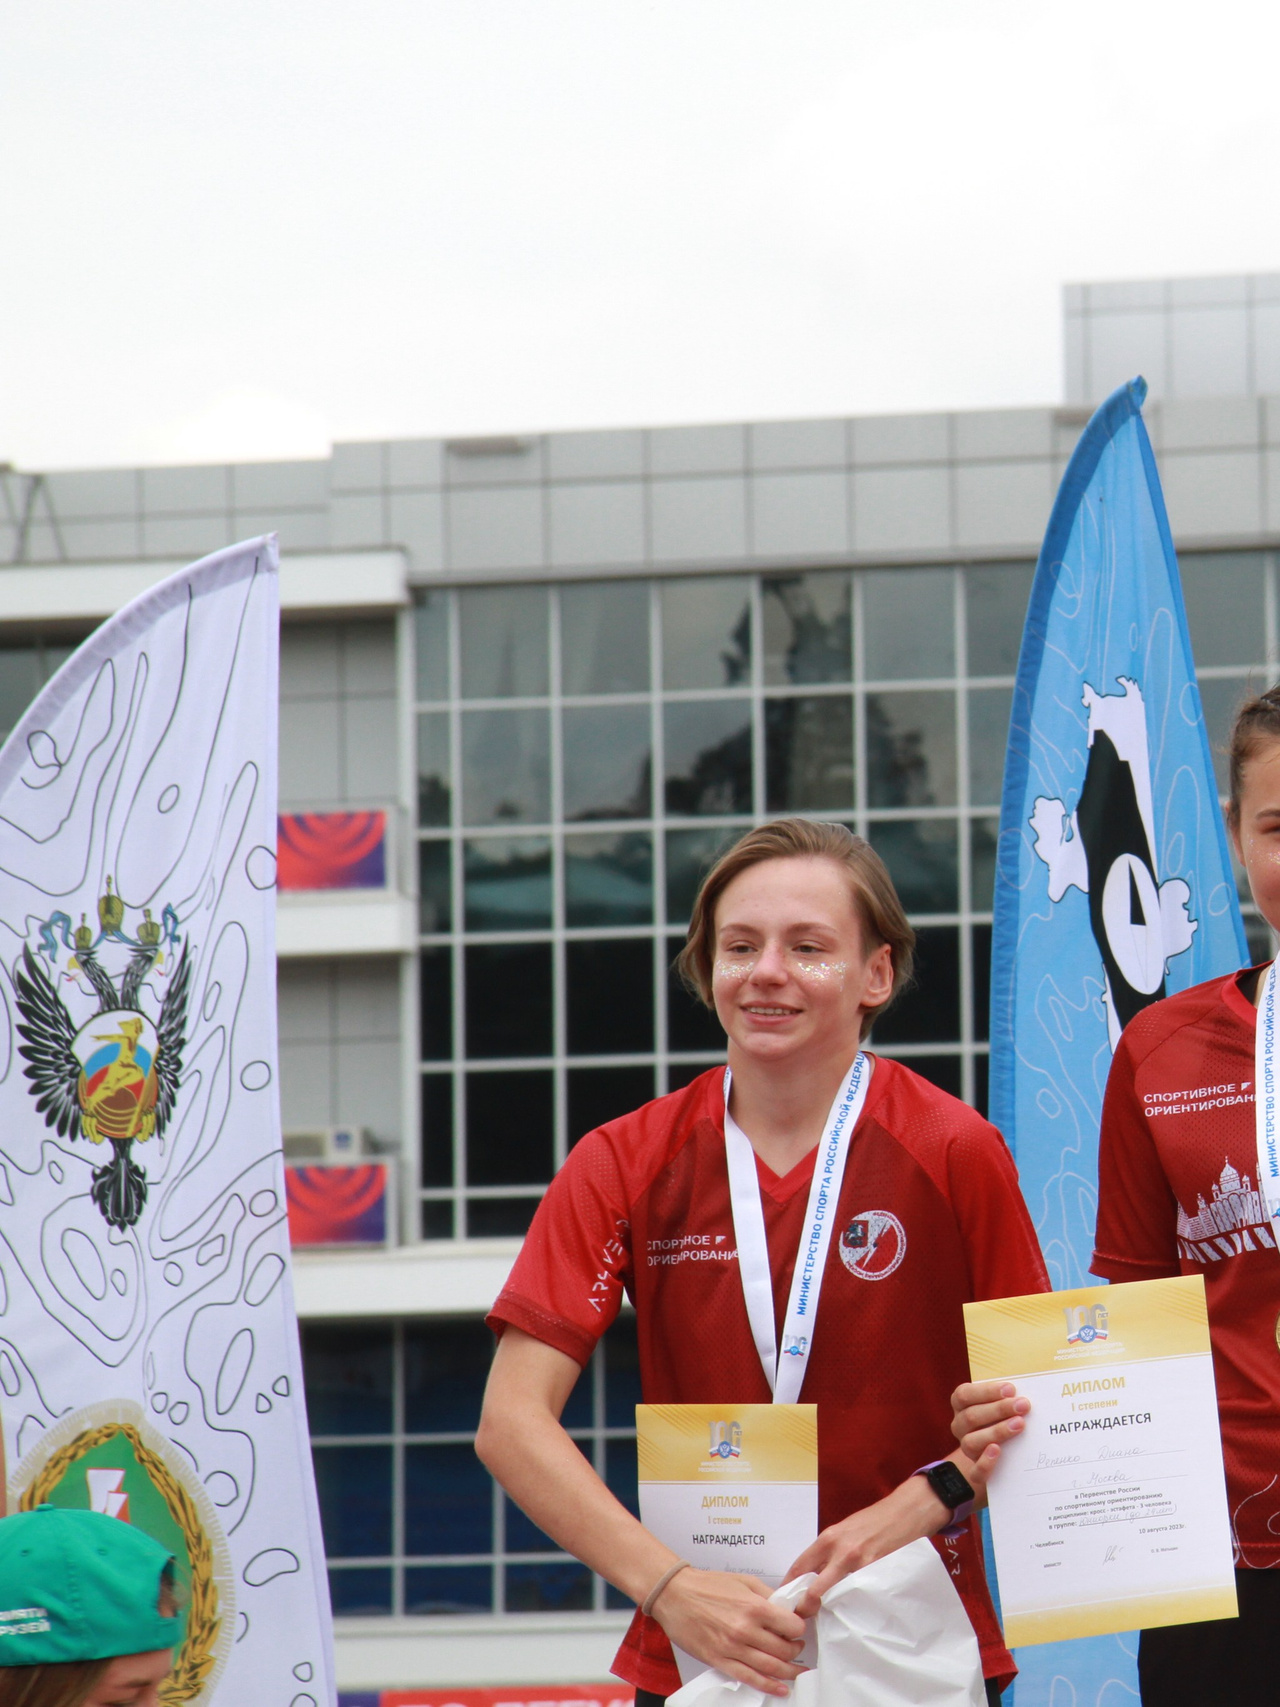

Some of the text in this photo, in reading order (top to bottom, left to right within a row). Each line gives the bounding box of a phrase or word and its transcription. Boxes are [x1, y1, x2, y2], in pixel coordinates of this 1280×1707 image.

[1264, 992, 1275, 1055] РОССИЙСКОЙ
[1265, 1056, 1275, 1094] СПОРТА
[1143, 1083, 1236, 1103] СПОРТИВНОЕ
[1144, 1094, 1257, 1117] ОРИЕНТИРОВАН
[1265, 1096, 1280, 1178] МИНИСТЕРСТВО
[796, 1051, 865, 1315] МИНИСТЕРСТВО СПОРТА РОССИЙСКОЙ ФЕДЕРАЦ
[1061, 1376, 1127, 1398] ДИПЛОМ
[1078, 1399, 1118, 1411] степени
[1049, 1412, 1152, 1435] НАГРАЖДАЕТСЯ
[1087, 1469, 1132, 1485] Москва
[701, 1495, 749, 1509] ДИПЛОМ
[1063, 1500, 1106, 1511] спортивному
[1106, 1492, 1163, 1506] ориентированию
[1079, 1489, 1117, 1500] Первенстве
[1117, 1486, 1141, 1494] России
[1052, 1511, 1089, 1522] дисциплине:
[1090, 1508, 1106, 1516] кросс
[1110, 1504, 1135, 1513] эстафета
[1144, 1500, 1172, 1509] человека
[713, 1517, 742, 1525] степени
[1053, 1521, 1078, 1530] группе:
[1146, 1526, 1168, 1534] августа
[692, 1534, 765, 1547] НАГРАЖДАЕТСЯ
[1034, 1540, 1064, 1548] Челябинск
